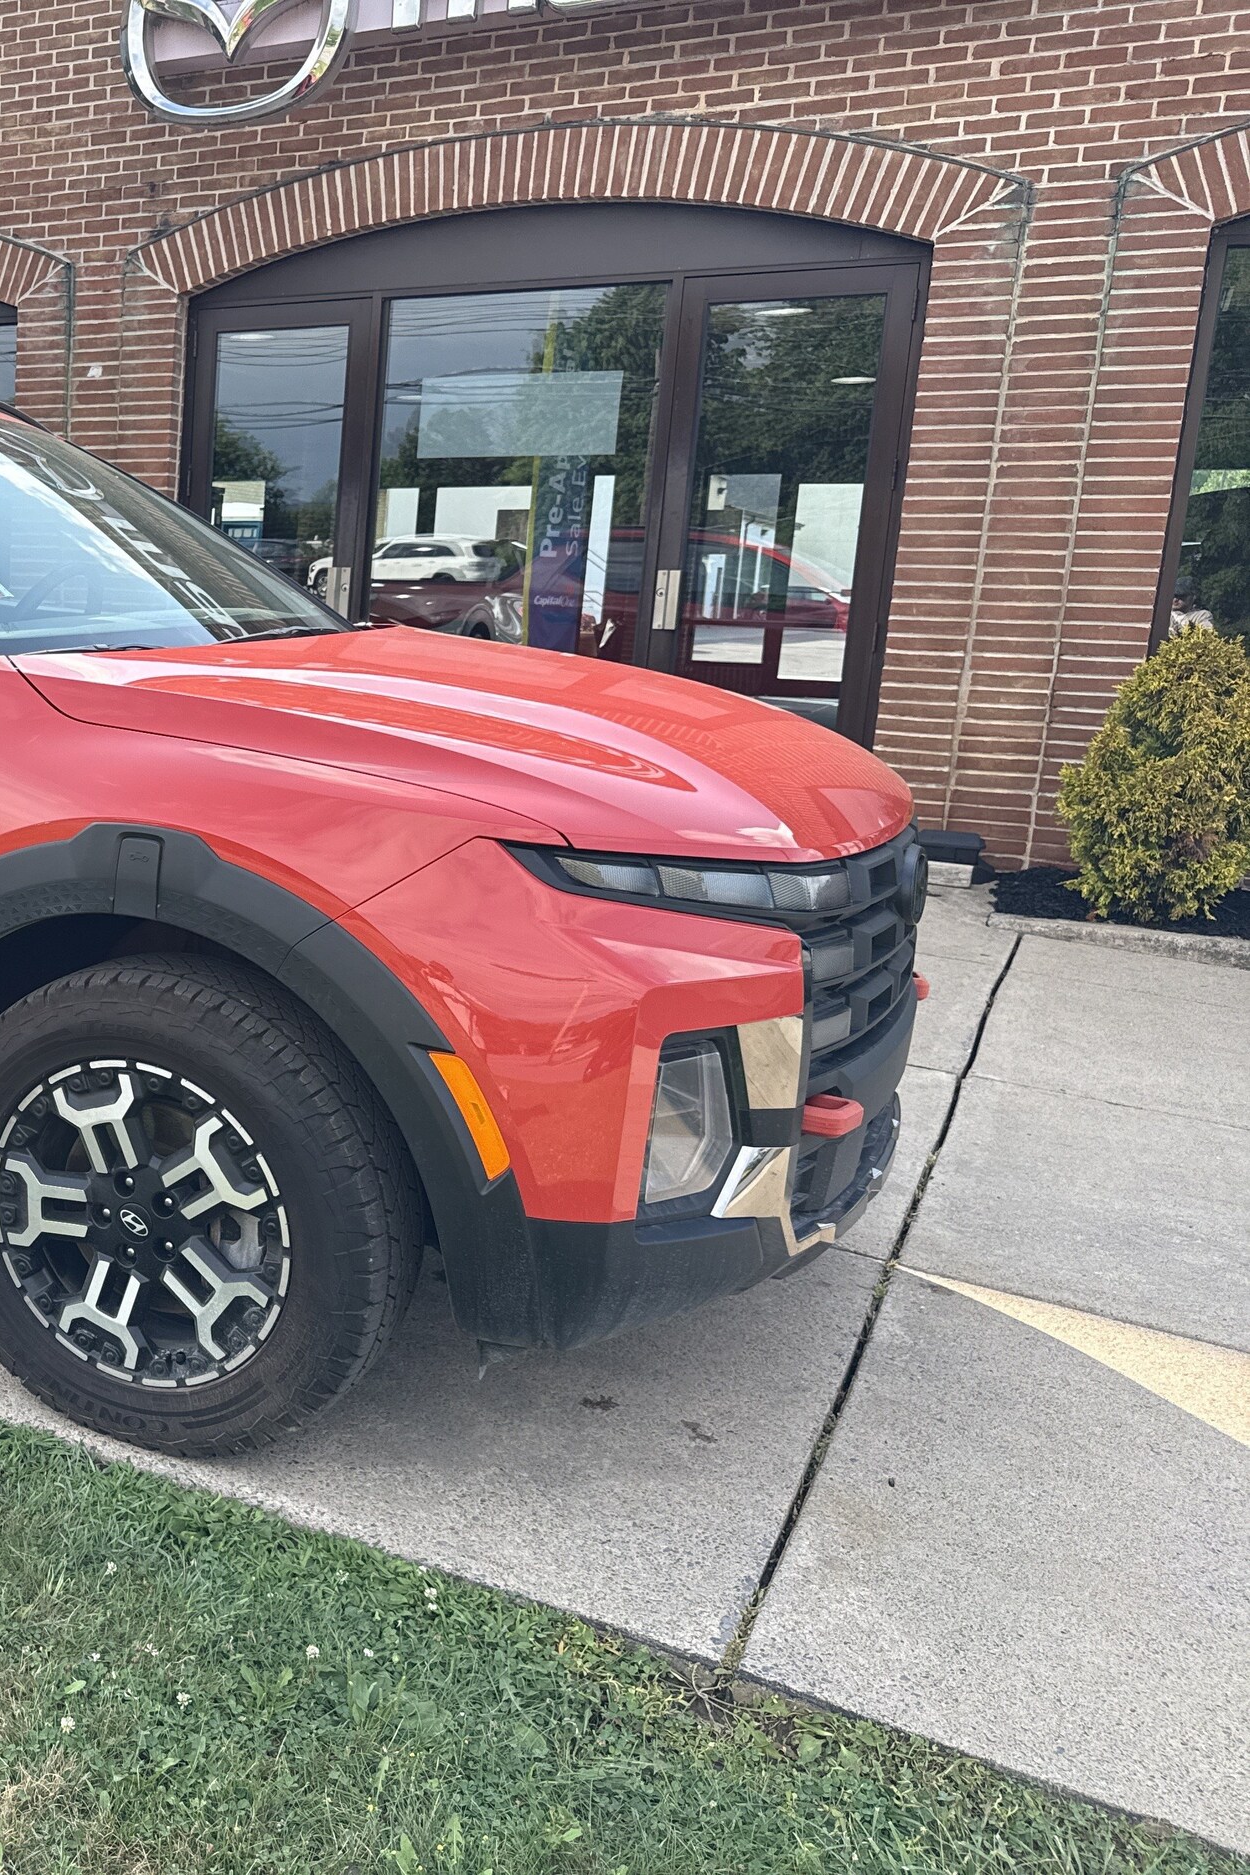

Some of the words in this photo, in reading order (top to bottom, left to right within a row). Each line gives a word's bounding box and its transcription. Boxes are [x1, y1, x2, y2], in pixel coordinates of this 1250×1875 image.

[572, 456, 587, 487] Ev
[540, 456, 571, 558] Pre-Ap
[565, 495, 584, 557] Sale
